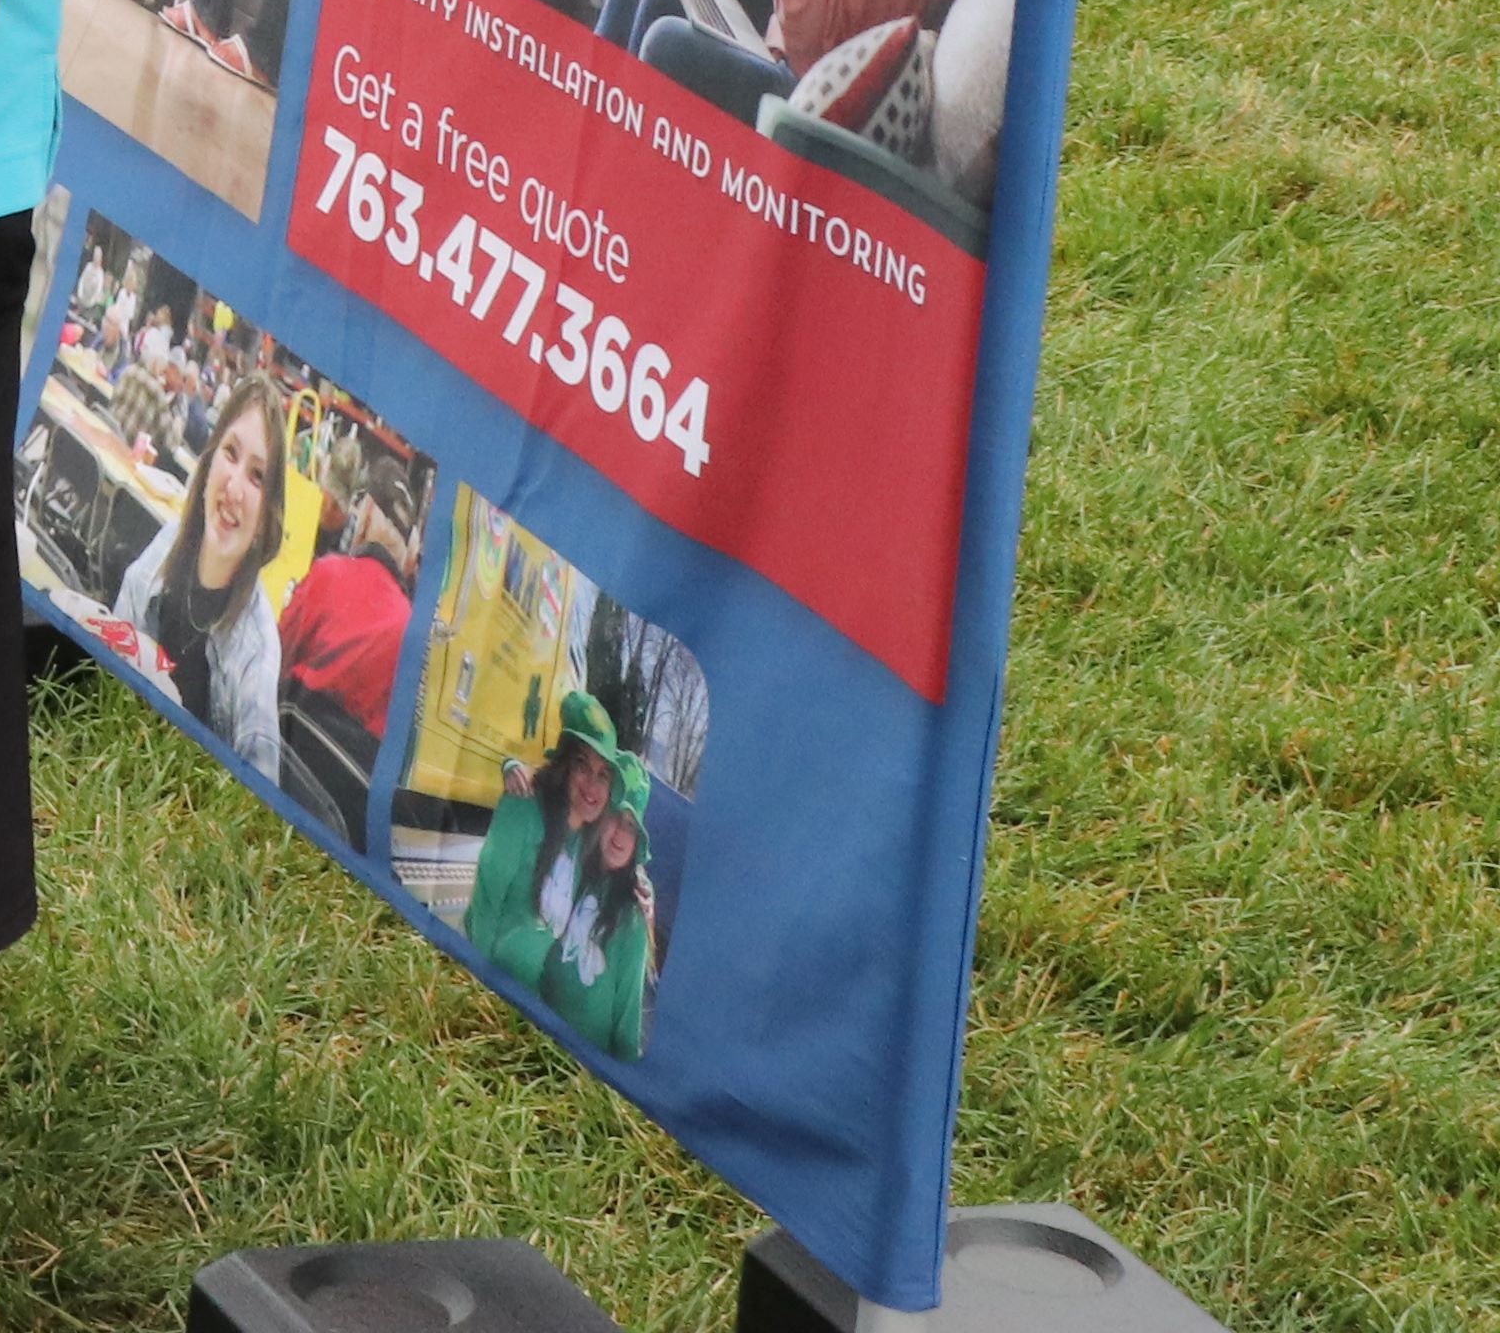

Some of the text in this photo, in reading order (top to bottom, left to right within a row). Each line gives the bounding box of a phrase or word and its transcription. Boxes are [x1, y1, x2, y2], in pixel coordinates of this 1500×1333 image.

[314, 126, 711, 478] 763.477.3664
[332, 45, 629, 285] Get a free quote
[465, 1, 645, 138] INSTALLATION
[652, 117, 711, 178] AND
[720, 158, 927, 307] MONITORING
